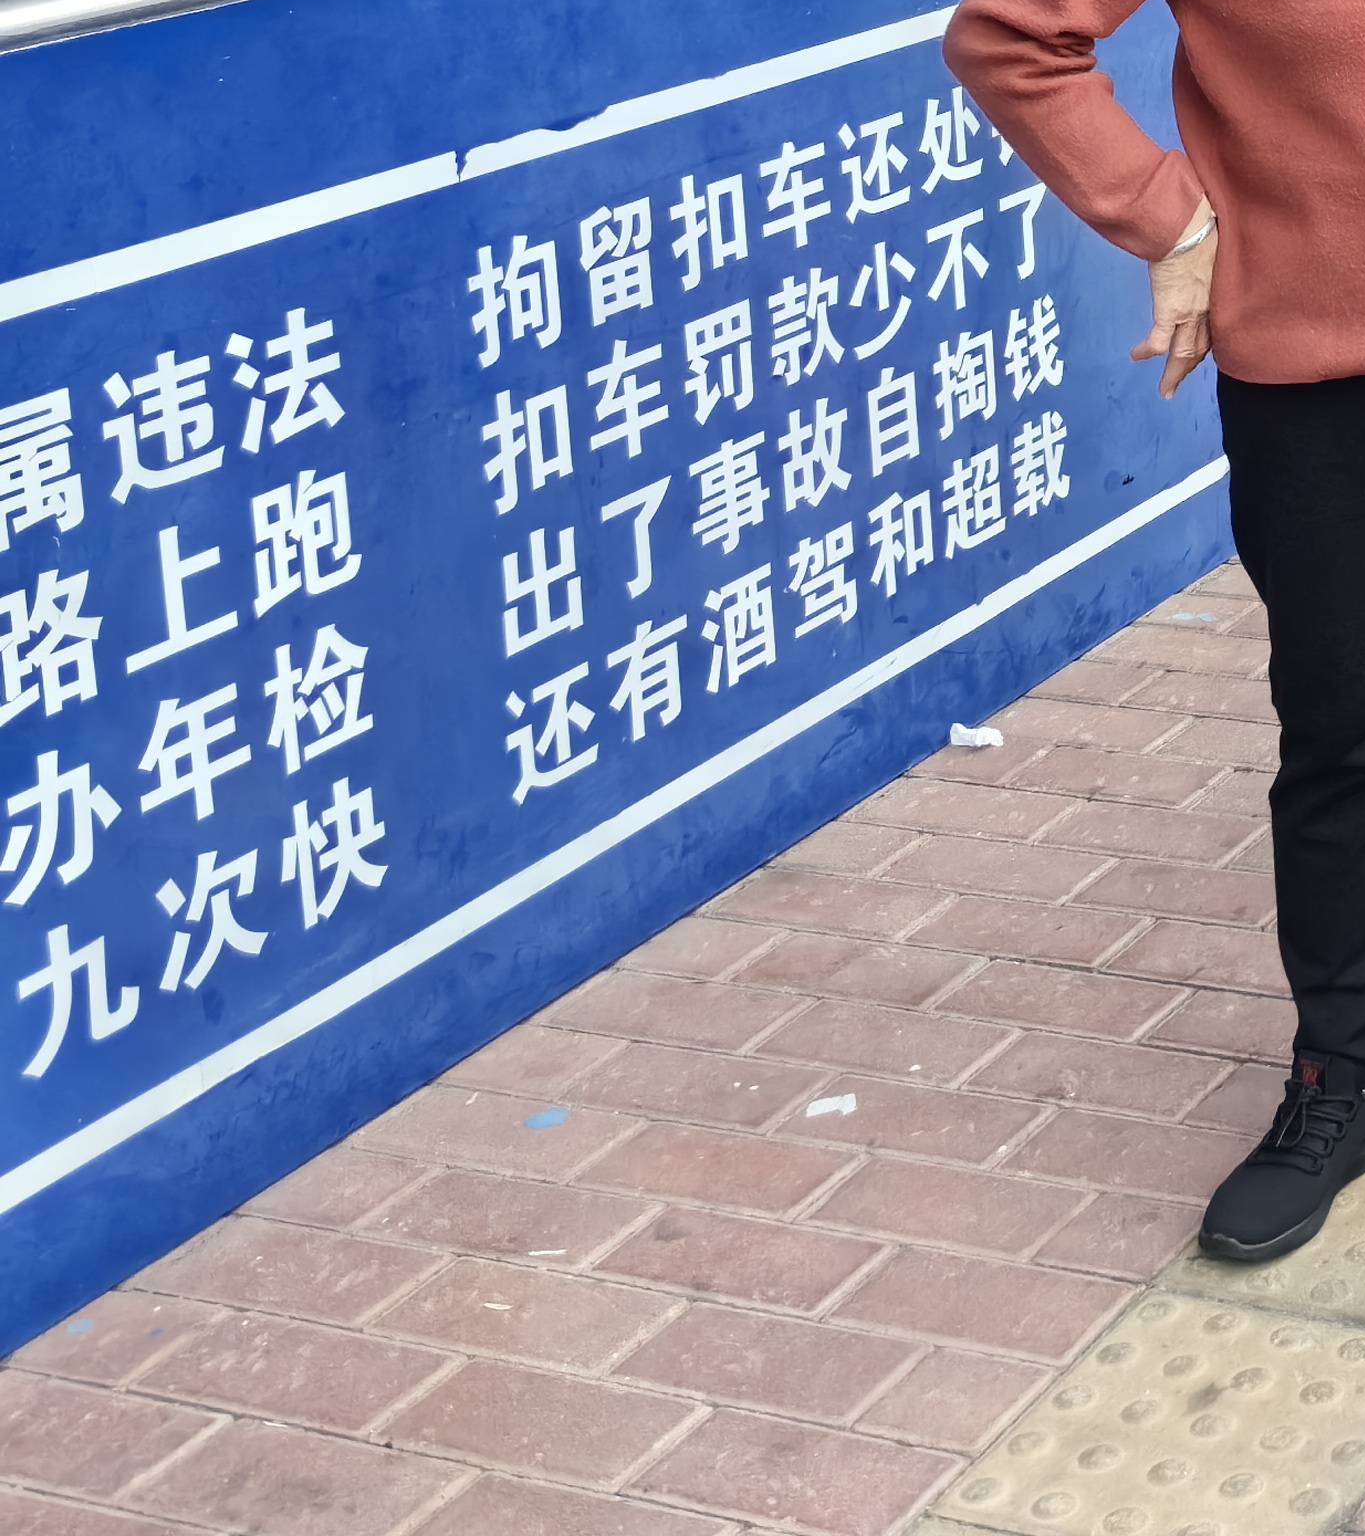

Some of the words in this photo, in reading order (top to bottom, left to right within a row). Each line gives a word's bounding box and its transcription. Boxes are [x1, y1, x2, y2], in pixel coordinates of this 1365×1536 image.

[472, 86, 1014, 367] 拘留扣车还处
[482, 183, 1047, 515] 扣车罚款少不了
[0, 307, 346, 552] 属违法
[503, 293, 1066, 659] 出了事故自掏钱
[0, 469, 362, 728] 路上跑
[505, 412, 1072, 805] 还有酒驾和超载
[4, 624, 374, 906] 办年检
[18, 778, 388, 1078] 九次快
